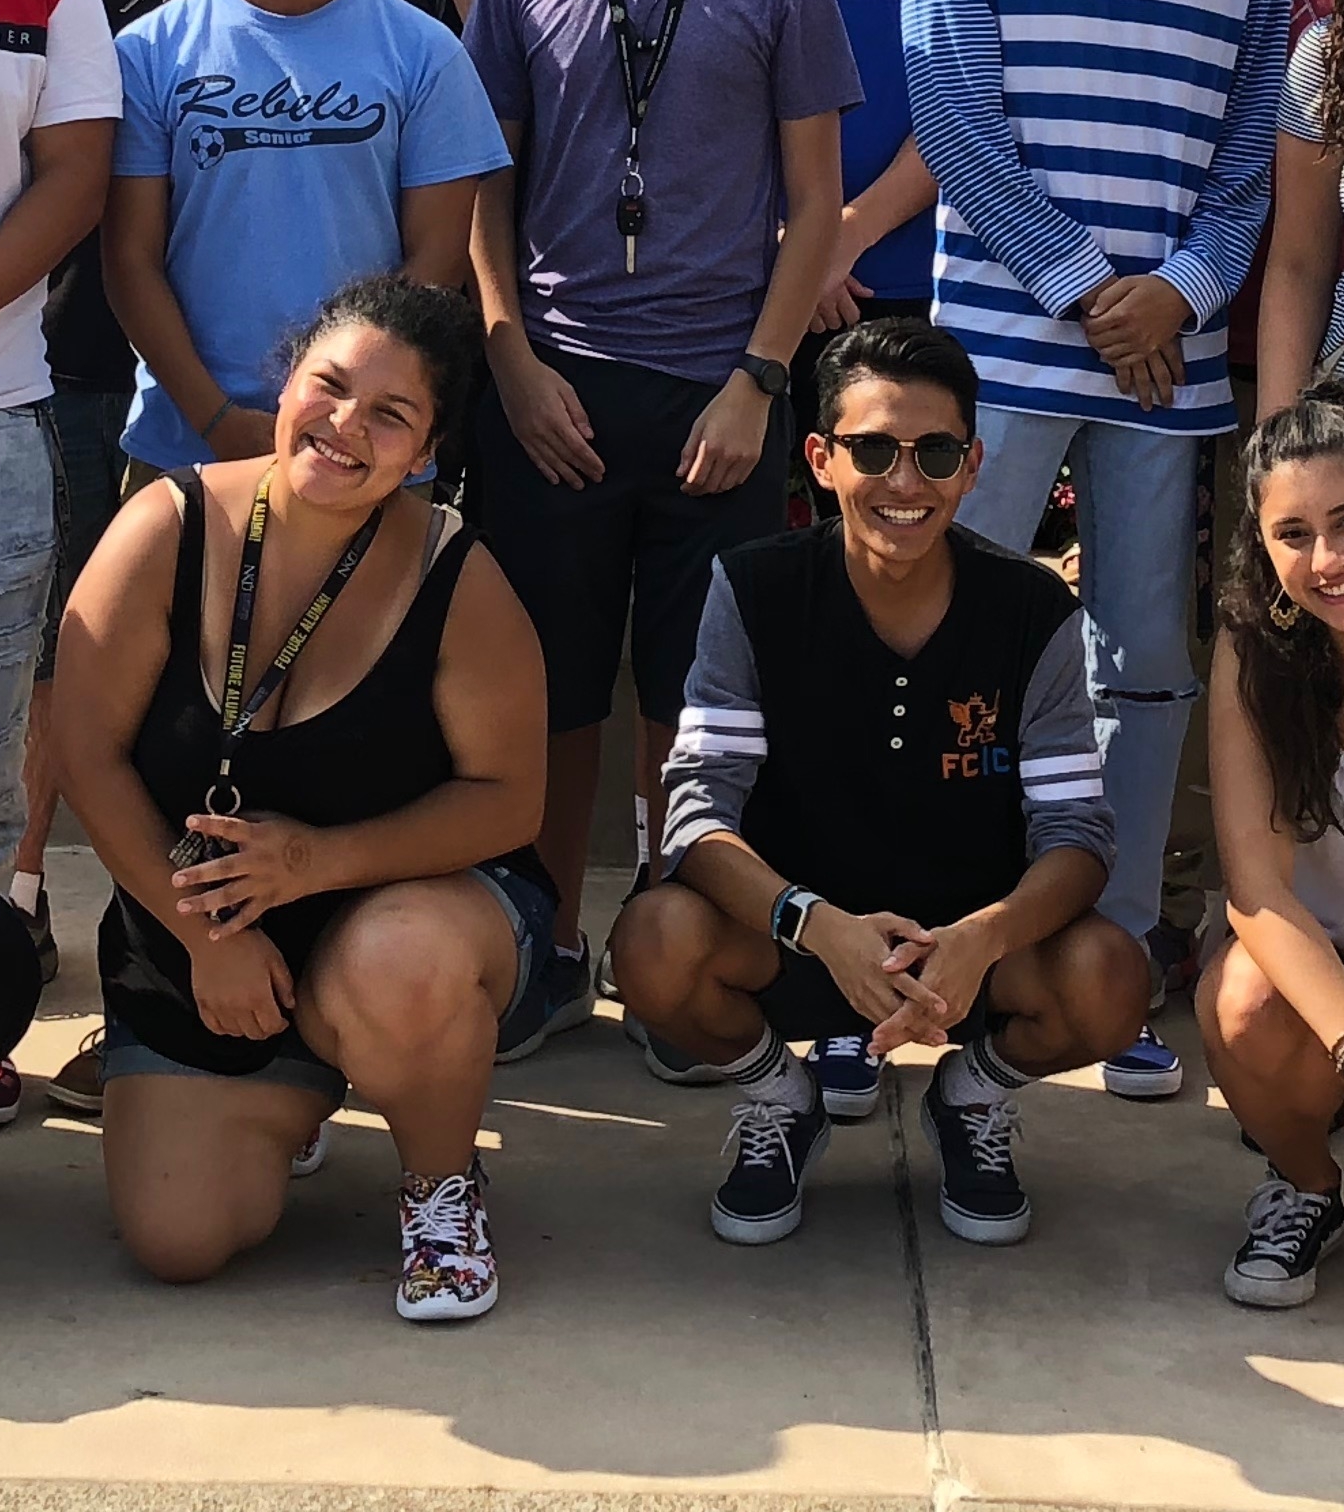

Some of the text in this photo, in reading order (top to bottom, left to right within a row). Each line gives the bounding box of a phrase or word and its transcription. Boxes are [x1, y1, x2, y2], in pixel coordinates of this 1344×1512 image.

[175, 75, 359, 127] Rebels
[244, 130, 313, 145] Senior
[227, 643, 247, 686] FUTURE
[273, 630, 309, 671] FUTURE
